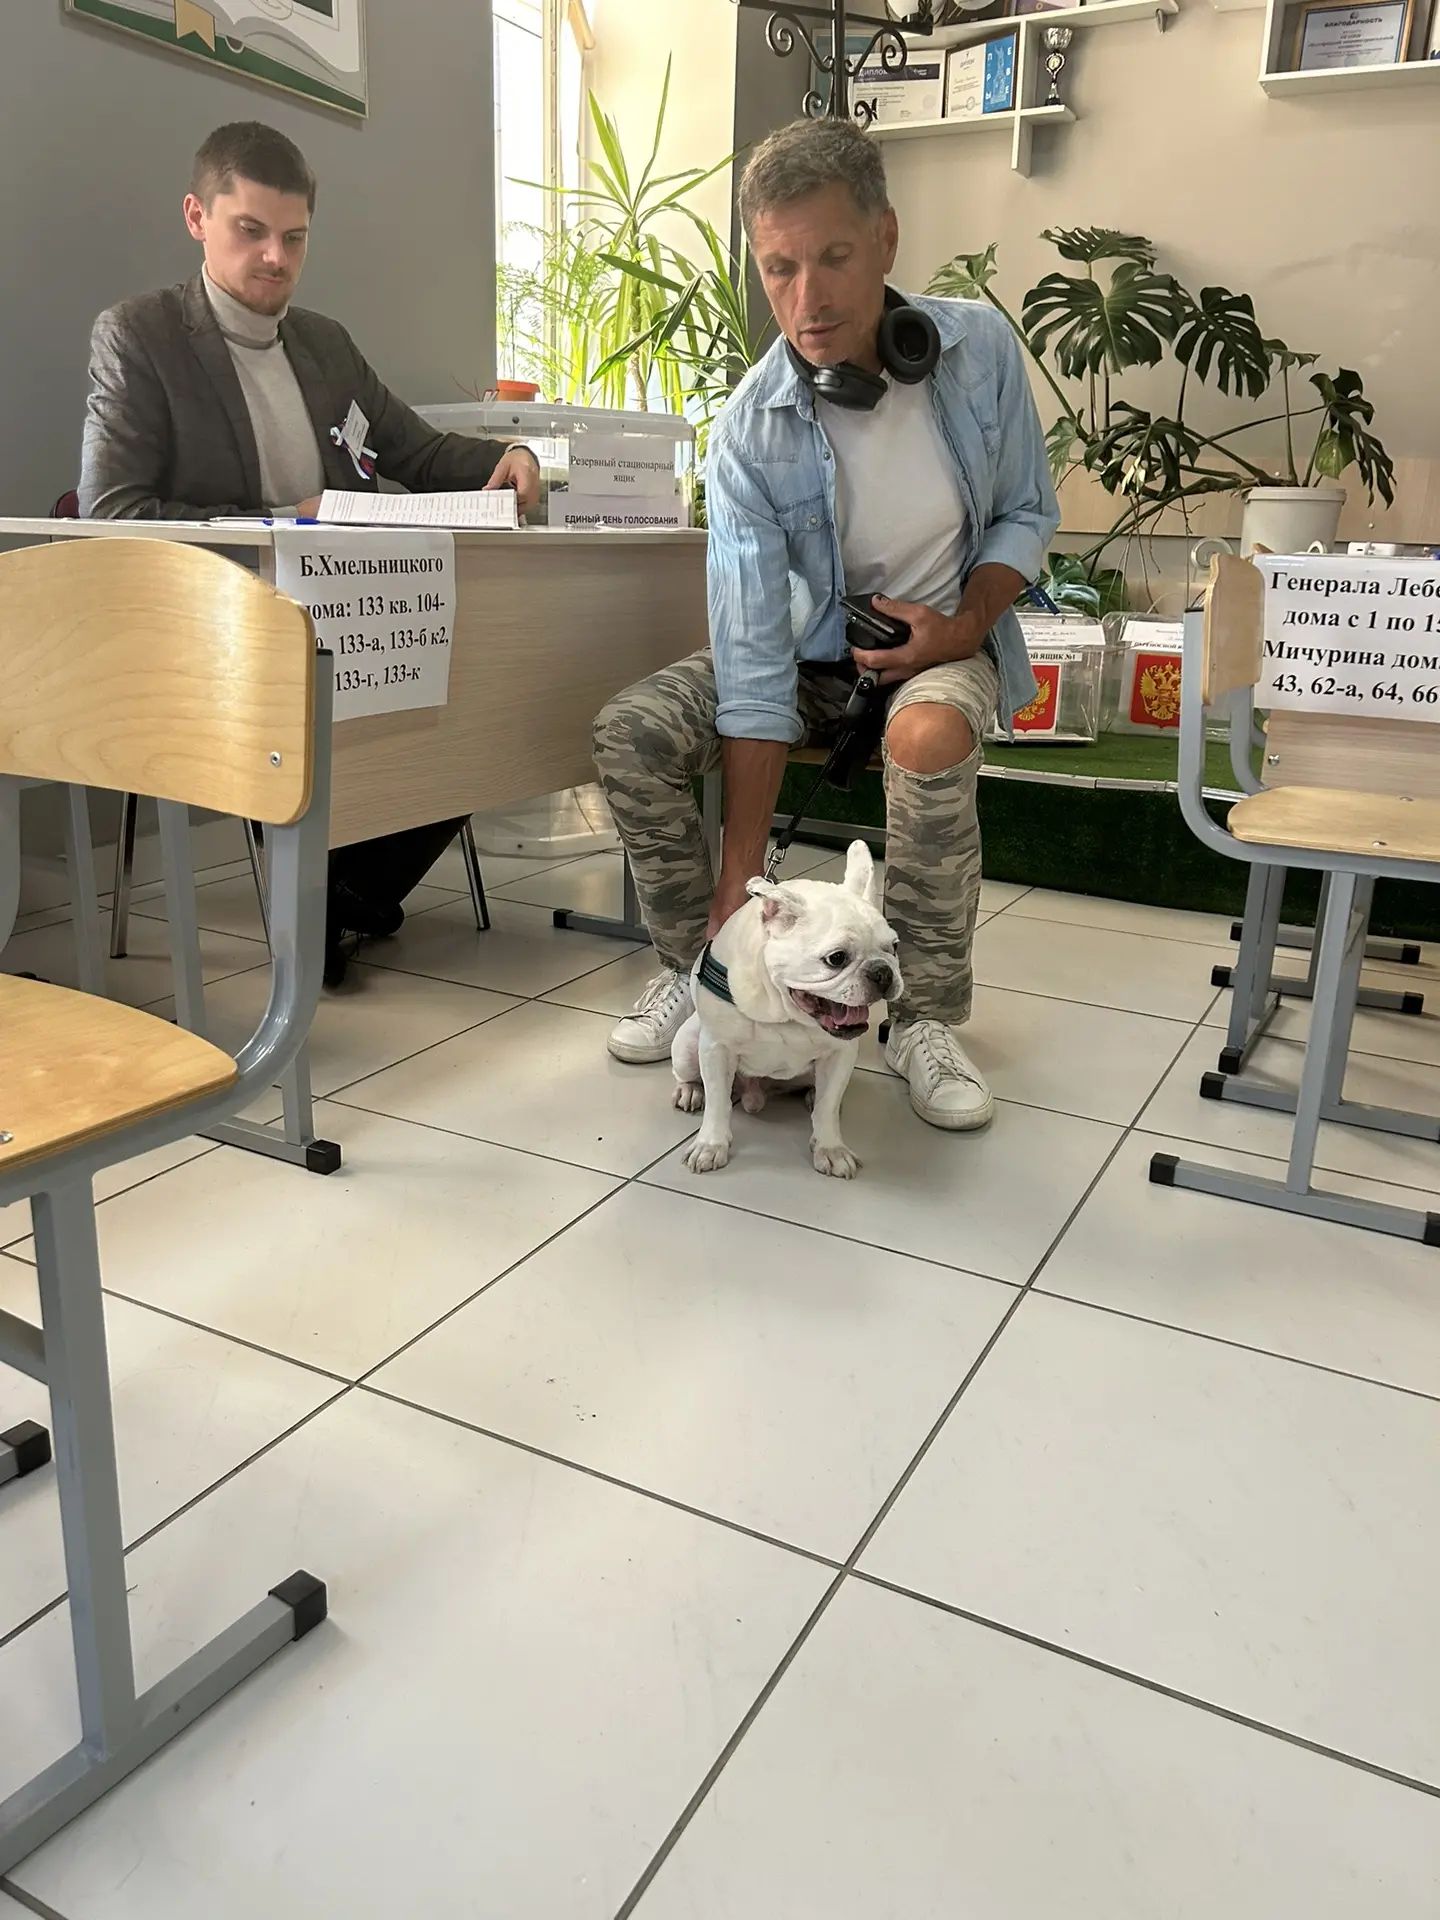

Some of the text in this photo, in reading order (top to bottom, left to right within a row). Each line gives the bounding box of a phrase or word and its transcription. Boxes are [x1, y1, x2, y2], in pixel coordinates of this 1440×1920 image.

[570, 455, 675, 473] Резервный стационарный
[613, 474, 636, 483] ящик
[565, 513, 679, 525] ЕДИНЫЙ ДЕНЬ ГОЛОСОВАНИЯ
[299, 554, 443, 577] Б.Хмельницкого
[1271, 571, 1380, 598] Генерала
[357, 596, 384, 617] 133
[389, 599, 412, 615] кв.
[416, 592, 445, 613] 104-
[1282, 609, 1340, 627] дома
[1347, 614, 1360, 628] с
[1367, 610, 1378, 629] 1
[1386, 615, 1415, 632] по
[338, 633, 385, 655] 133-а,
[390, 627, 427, 650] 133-б
[430, 626, 449, 648] к2,
[1039, 652, 1064, 660] ЯЩИК
[1262, 639, 1440, 670] Мичурина дом
[335, 663, 421, 692] 133-г, 133-к
[1272, 673, 1439, 705] 43, 62-а, 64, 66
